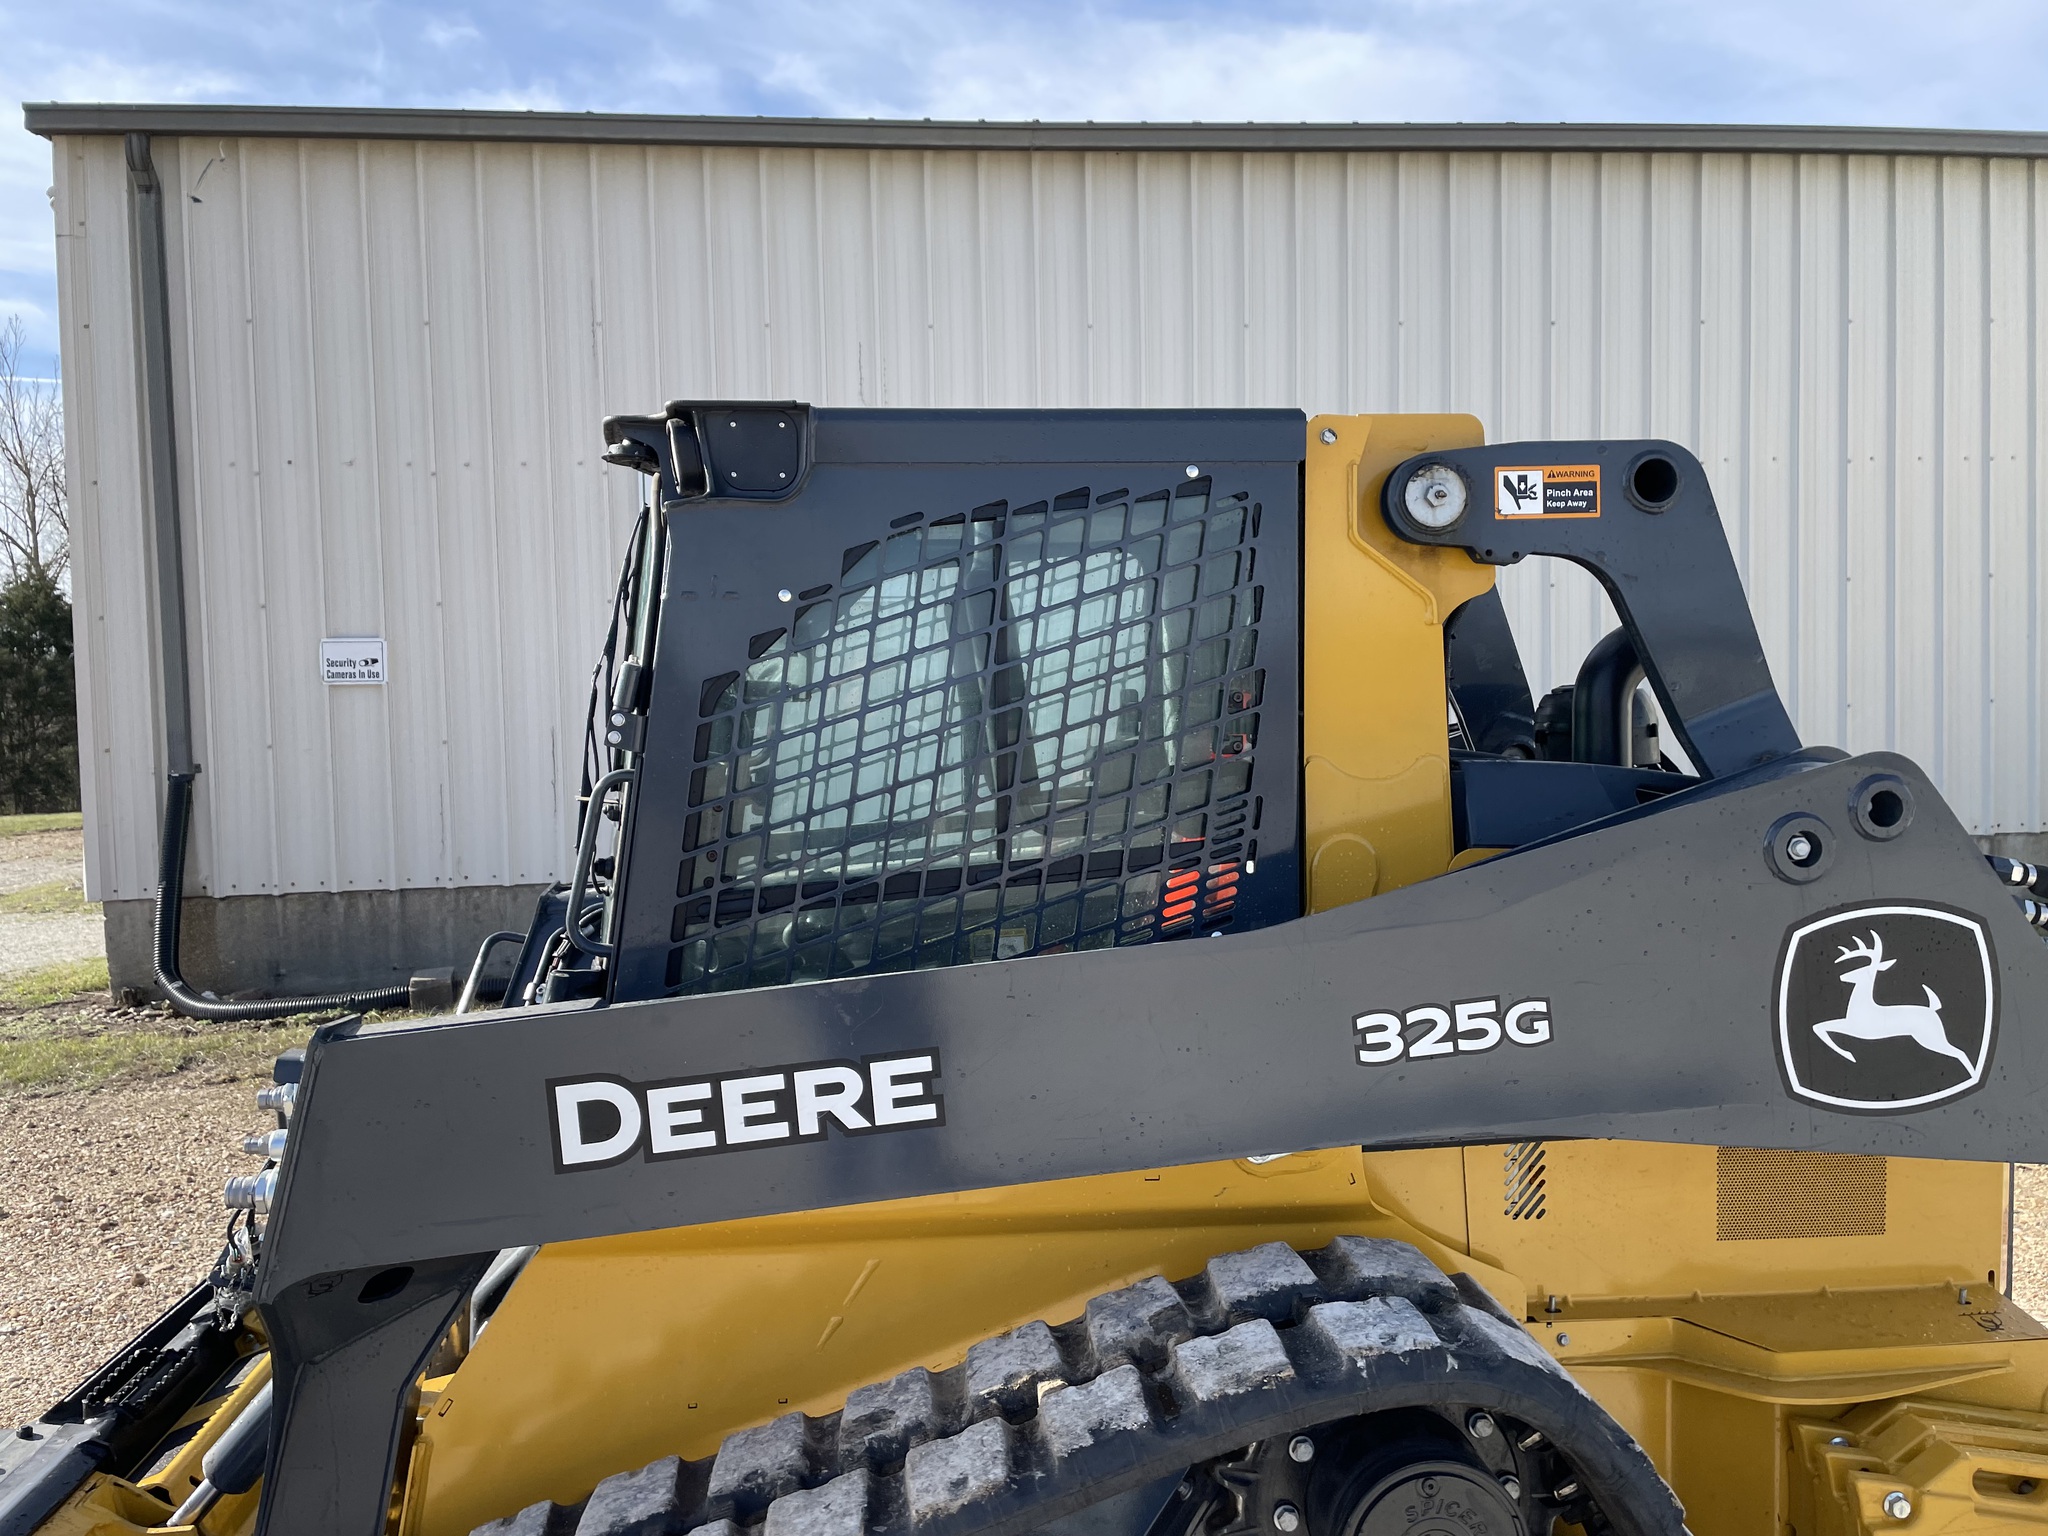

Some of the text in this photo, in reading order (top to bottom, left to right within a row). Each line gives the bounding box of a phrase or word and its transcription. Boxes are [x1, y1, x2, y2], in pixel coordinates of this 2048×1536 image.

[1556, 470, 1595, 478] WARNING
[1546, 488, 1594, 497] Pinch Area
[1546, 500, 1587, 508] Keep Away
[326, 658, 357, 669] Security
[326, 669, 380, 679] Cameras In Use
[1355, 999, 1551, 1064] 325G
[555, 1055, 937, 1166] DEERE
[1404, 1498, 1488, 1536] SPICER
